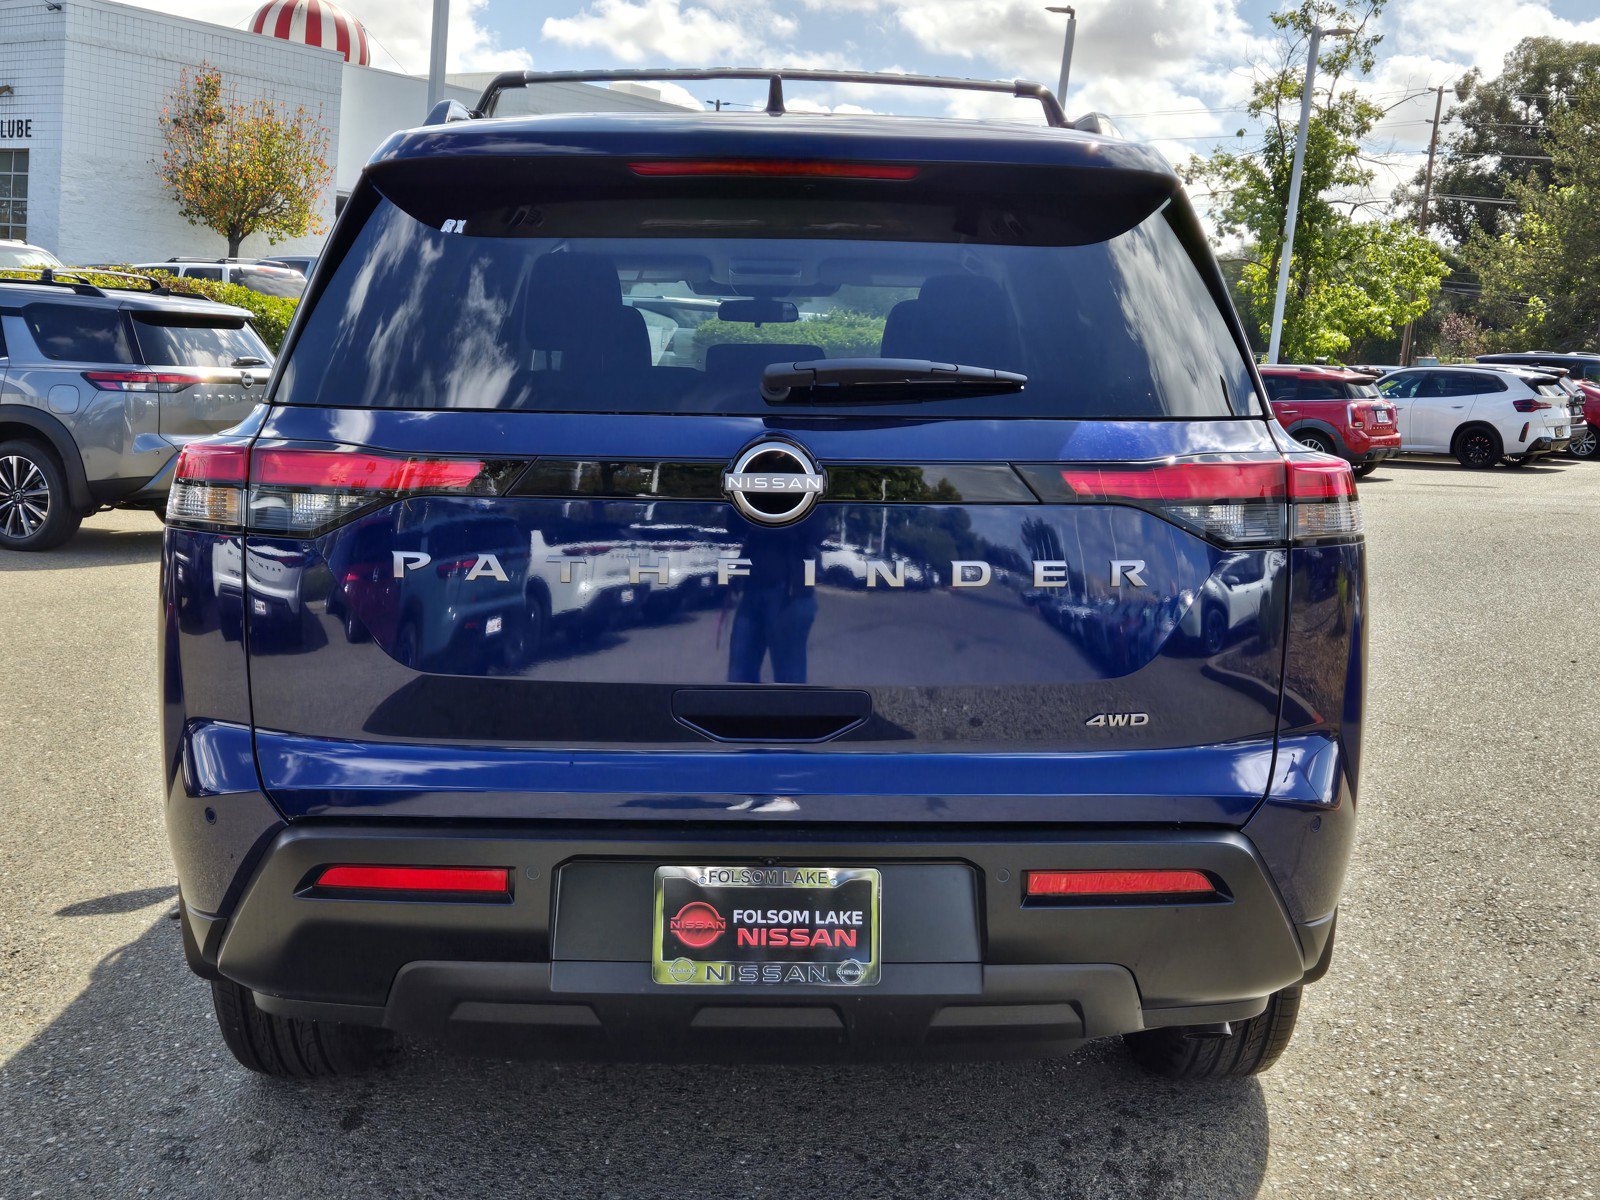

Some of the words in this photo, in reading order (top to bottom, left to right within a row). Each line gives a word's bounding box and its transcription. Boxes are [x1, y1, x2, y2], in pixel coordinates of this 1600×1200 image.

[1, 119, 32, 138] LUBE
[728, 477, 820, 489] NISSAN
[392, 550, 1148, 588] PATHFINDER
[1086, 713, 1149, 727] 4WD
[709, 870, 777, 885] FOLSOM
[783, 870, 828, 885] LAKE
[670, 921, 726, 929] NISSAN
[733, 909, 810, 924] FOLSOM
[815, 911, 863, 925] LAKE
[737, 928, 857, 947] NISSAN
[706, 965, 829, 983] NISSAN
